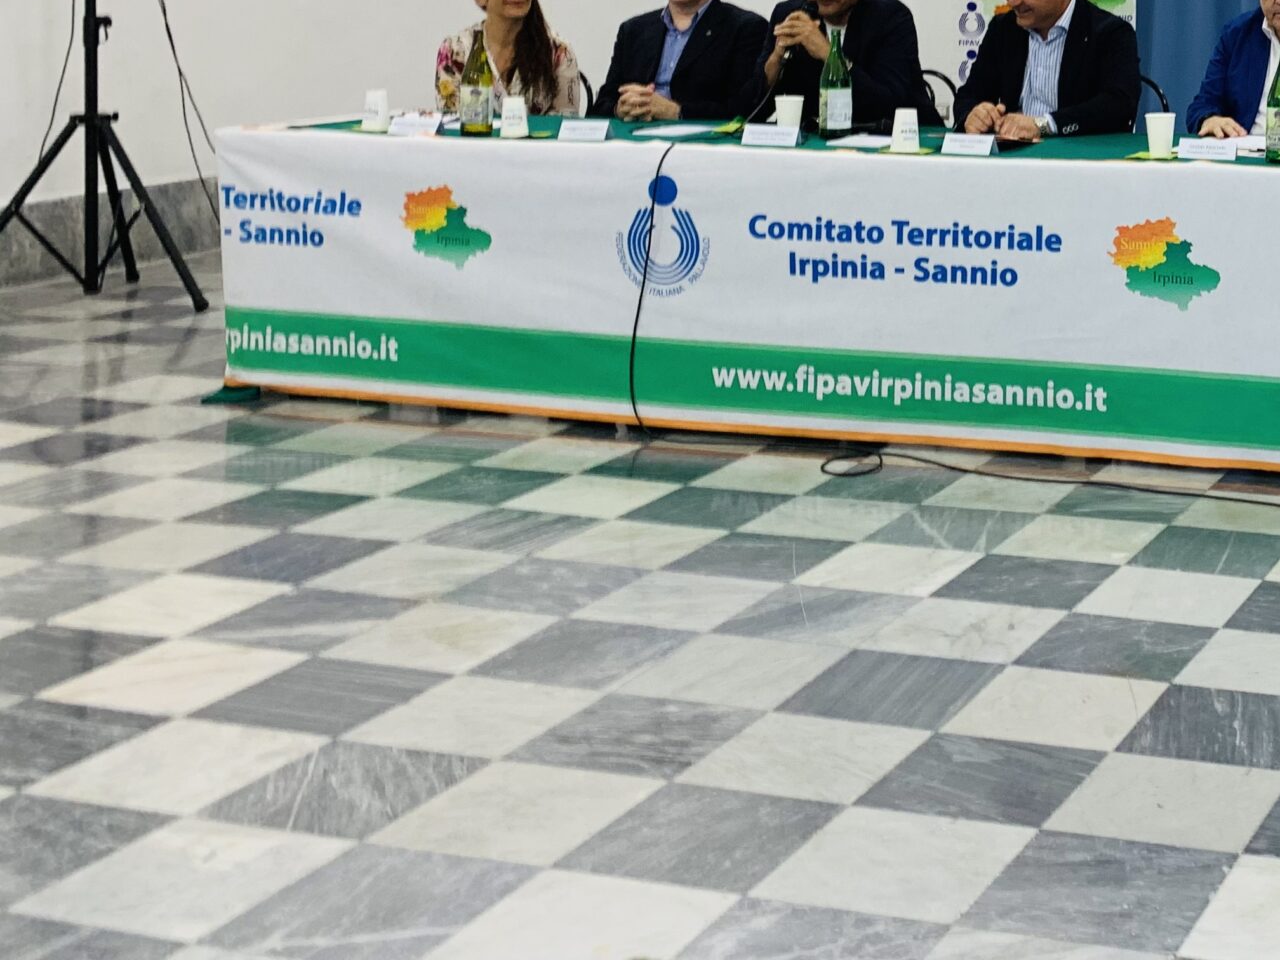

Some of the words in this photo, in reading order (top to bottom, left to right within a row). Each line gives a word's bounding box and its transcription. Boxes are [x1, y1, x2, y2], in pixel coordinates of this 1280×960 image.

[221, 185, 362, 217] Territoriale
[239, 220, 325, 248] Sannio
[748, 214, 885, 245] Comitato
[891, 219, 1063, 253] Territoriale
[788, 252, 885, 283] Irpinia
[914, 257, 1018, 287] Sannio
[1153, 271, 1194, 287] Irpinia
[712, 364, 1108, 412] www.fipavirpiniasannio.it
